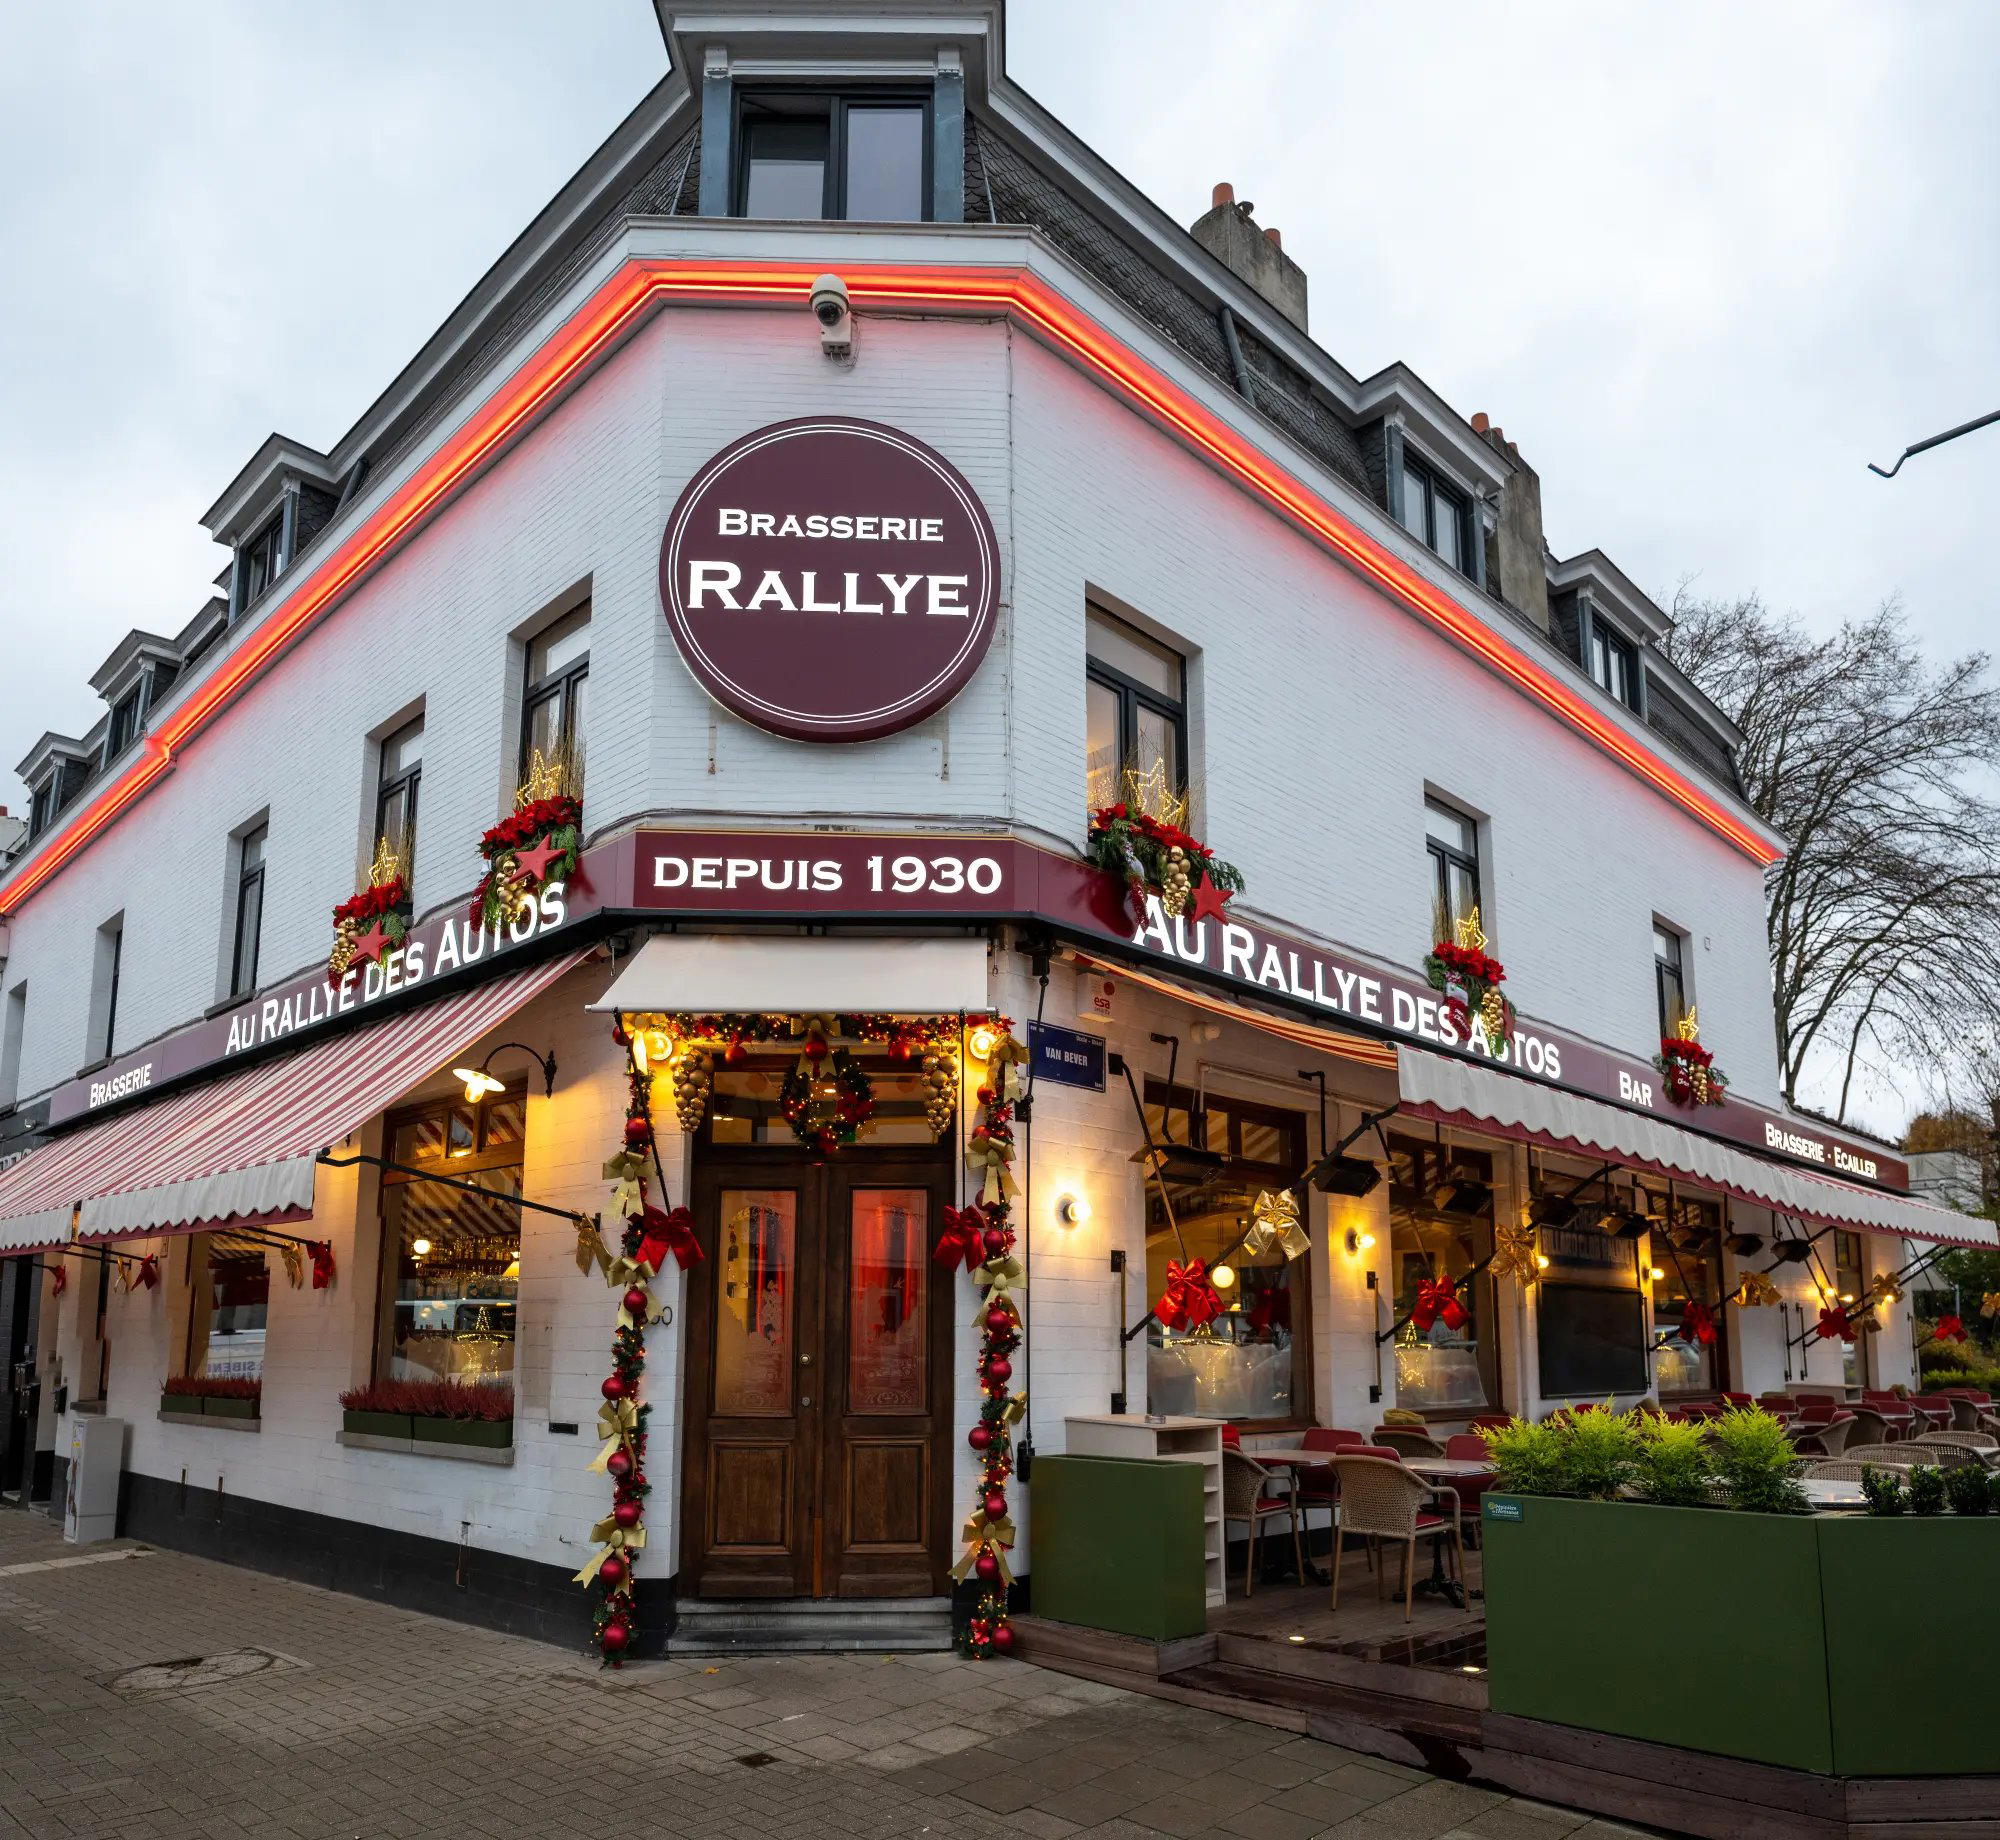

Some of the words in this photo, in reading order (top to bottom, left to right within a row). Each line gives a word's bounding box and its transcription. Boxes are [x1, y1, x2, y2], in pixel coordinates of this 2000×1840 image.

[717, 508, 944, 542] BRASSERIE
[687, 560, 970, 618] RALLYE
[653, 857, 843, 892] DEPUIS
[867, 855, 1002, 895] 1930
[1131, 893, 1206, 963] AU
[1221, 923, 1384, 1024] RALLYE
[1392, 988, 1460, 1047] DES
[225, 1015, 256, 1056] AU
[260, 969, 357, 1042] RALLYE
[364, 942, 425, 1003] DES
[1045, 1046, 1062, 1061] VAN
[1064, 1051, 1088, 1067] BEVER
[89, 1062, 153, 1109] BRASSERIE
[1618, 1070, 1653, 1108] BAR
[1765, 1122, 1825, 1163] BRASSERIE
[1833, 1146, 1877, 1180] ECAILLER
